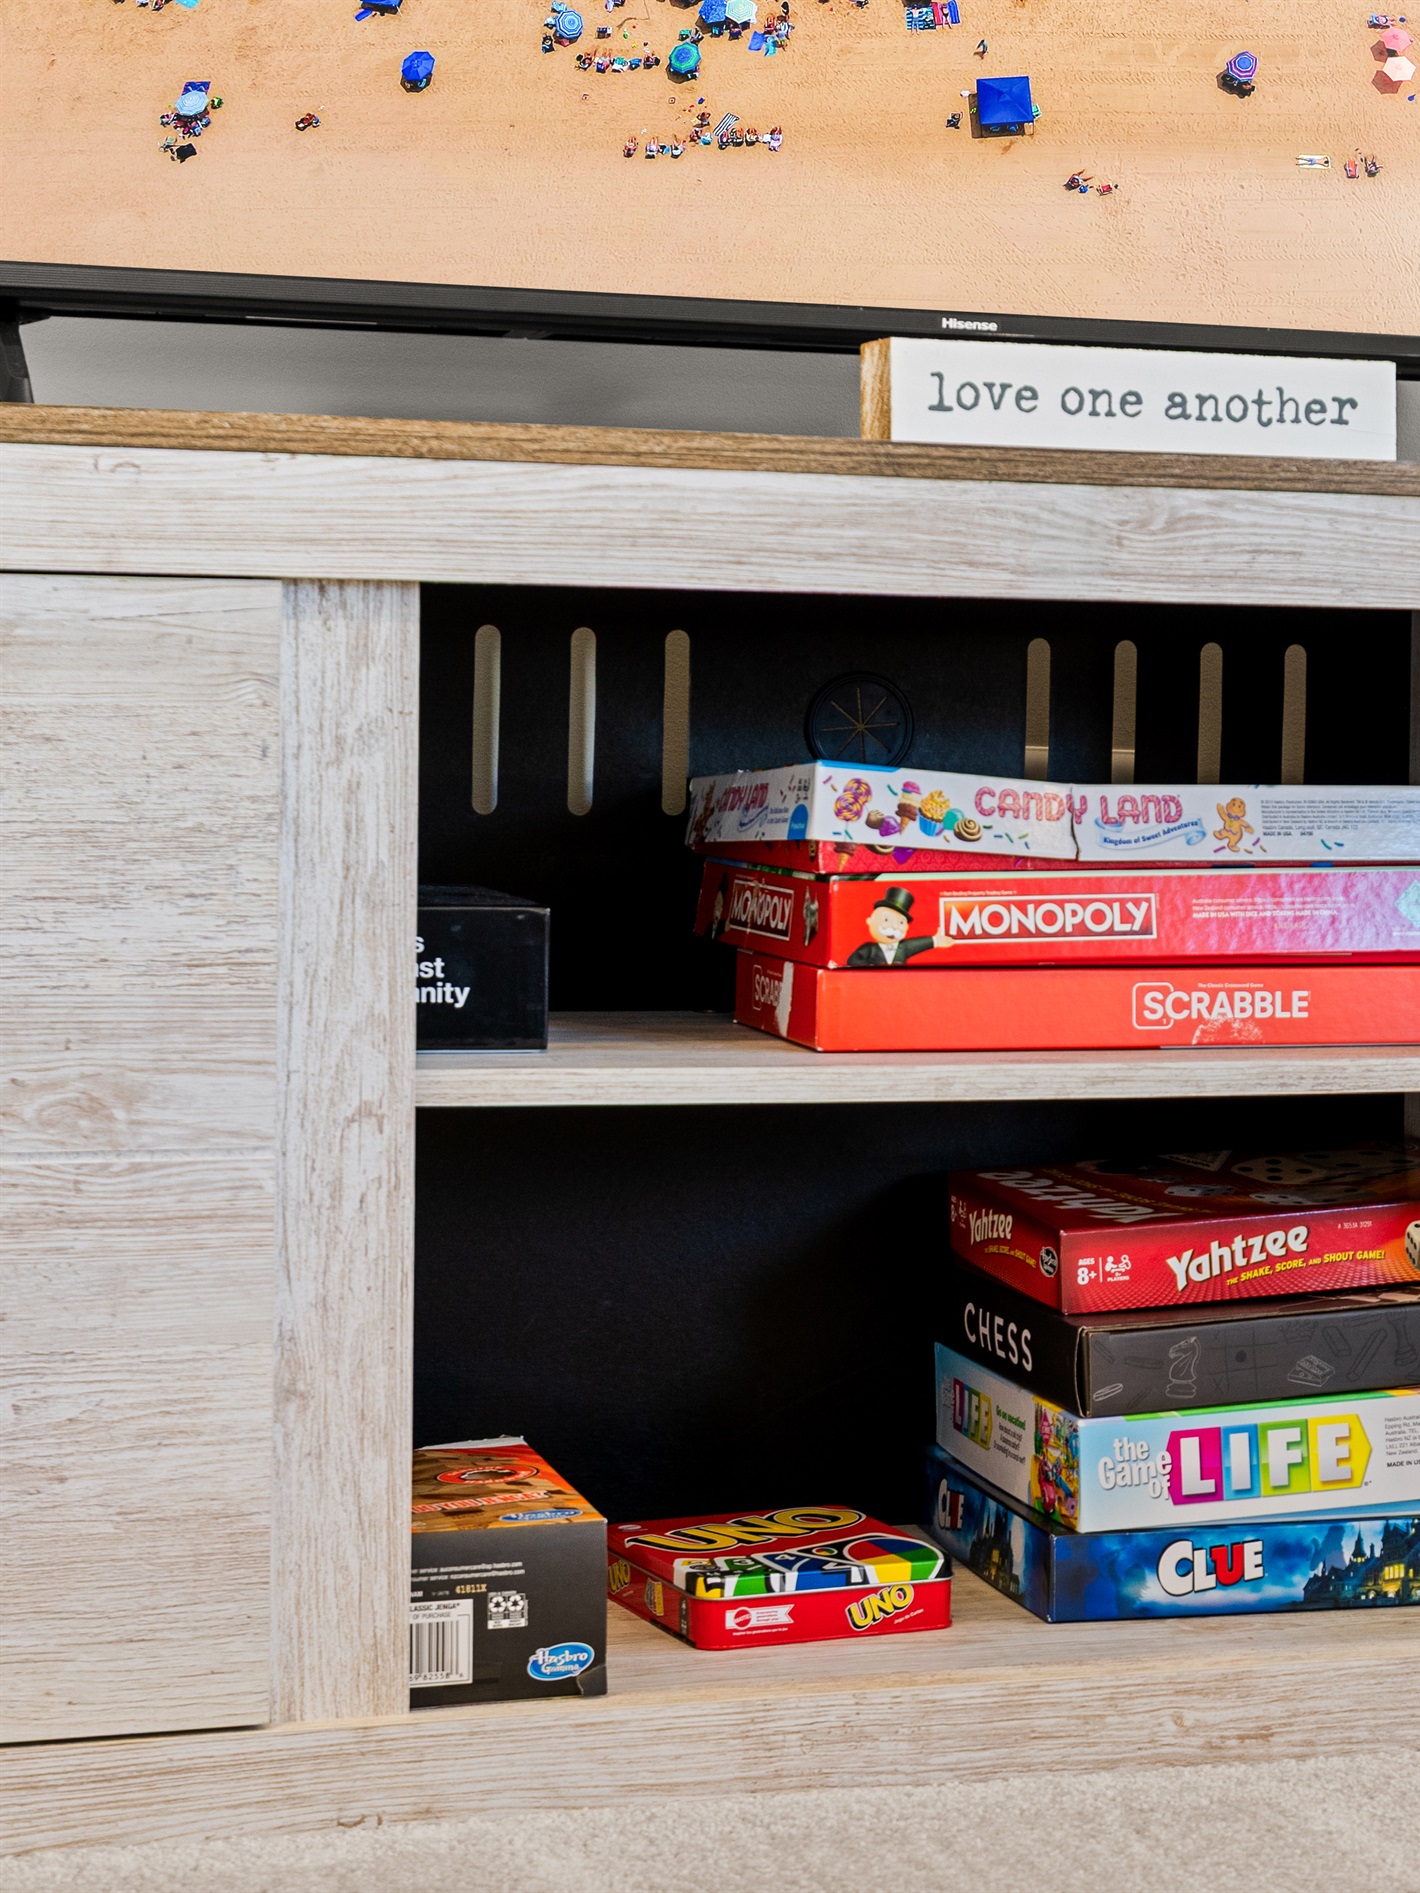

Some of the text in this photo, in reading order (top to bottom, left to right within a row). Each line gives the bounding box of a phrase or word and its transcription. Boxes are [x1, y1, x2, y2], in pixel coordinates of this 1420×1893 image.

[942, 317, 998, 331] Hisense
[928, 372, 1359, 428] love one another
[974, 786, 1183, 825] CANDY LAND
[1103, 836, 1132, 846] Kingdom
[1142, 832, 1161, 842] Sweet
[1162, 820, 1198, 836] Adventures
[731, 889, 791, 931] MONOPOLY
[949, 901, 1149, 936] MONOPOLY
[1143, 990, 1309, 1020] SCRABBLE
[969, 1208, 1013, 1246] Yahtzee
[1077, 1267, 1098, 1285] 8+
[1078, 1257, 1096, 1266] AGES
[1166, 1225, 1310, 1292] Yahtzee
[1226, 1250, 1386, 1286] THE SHAKE, SCORE, AND SHOUT GAME!
[964, 1302, 1033, 1372] CHESS
[955, 1383, 989, 1443] LIFE
[1385, 1423, 1402, 1431] Epping
[1113, 1436, 1151, 1463] the
[1386, 1435, 1403, 1443] Hasbro
[1098, 1449, 1173, 1491] Game
[1179, 1422, 1353, 1496] LIFE
[1386, 1459, 1404, 1468] MADE
[938, 1478, 965, 1530] CLUE
[1149, 1475, 1171, 1500] of
[626, 1508, 866, 1553] UNO
[608, 1560, 631, 1595] UNO
[1156, 1538, 1264, 1597] CLUE
[455, 1583, 488, 1594] 41811X
[845, 1583, 915, 1631] UNO
[530, 1649, 589, 1666] Hasbro
